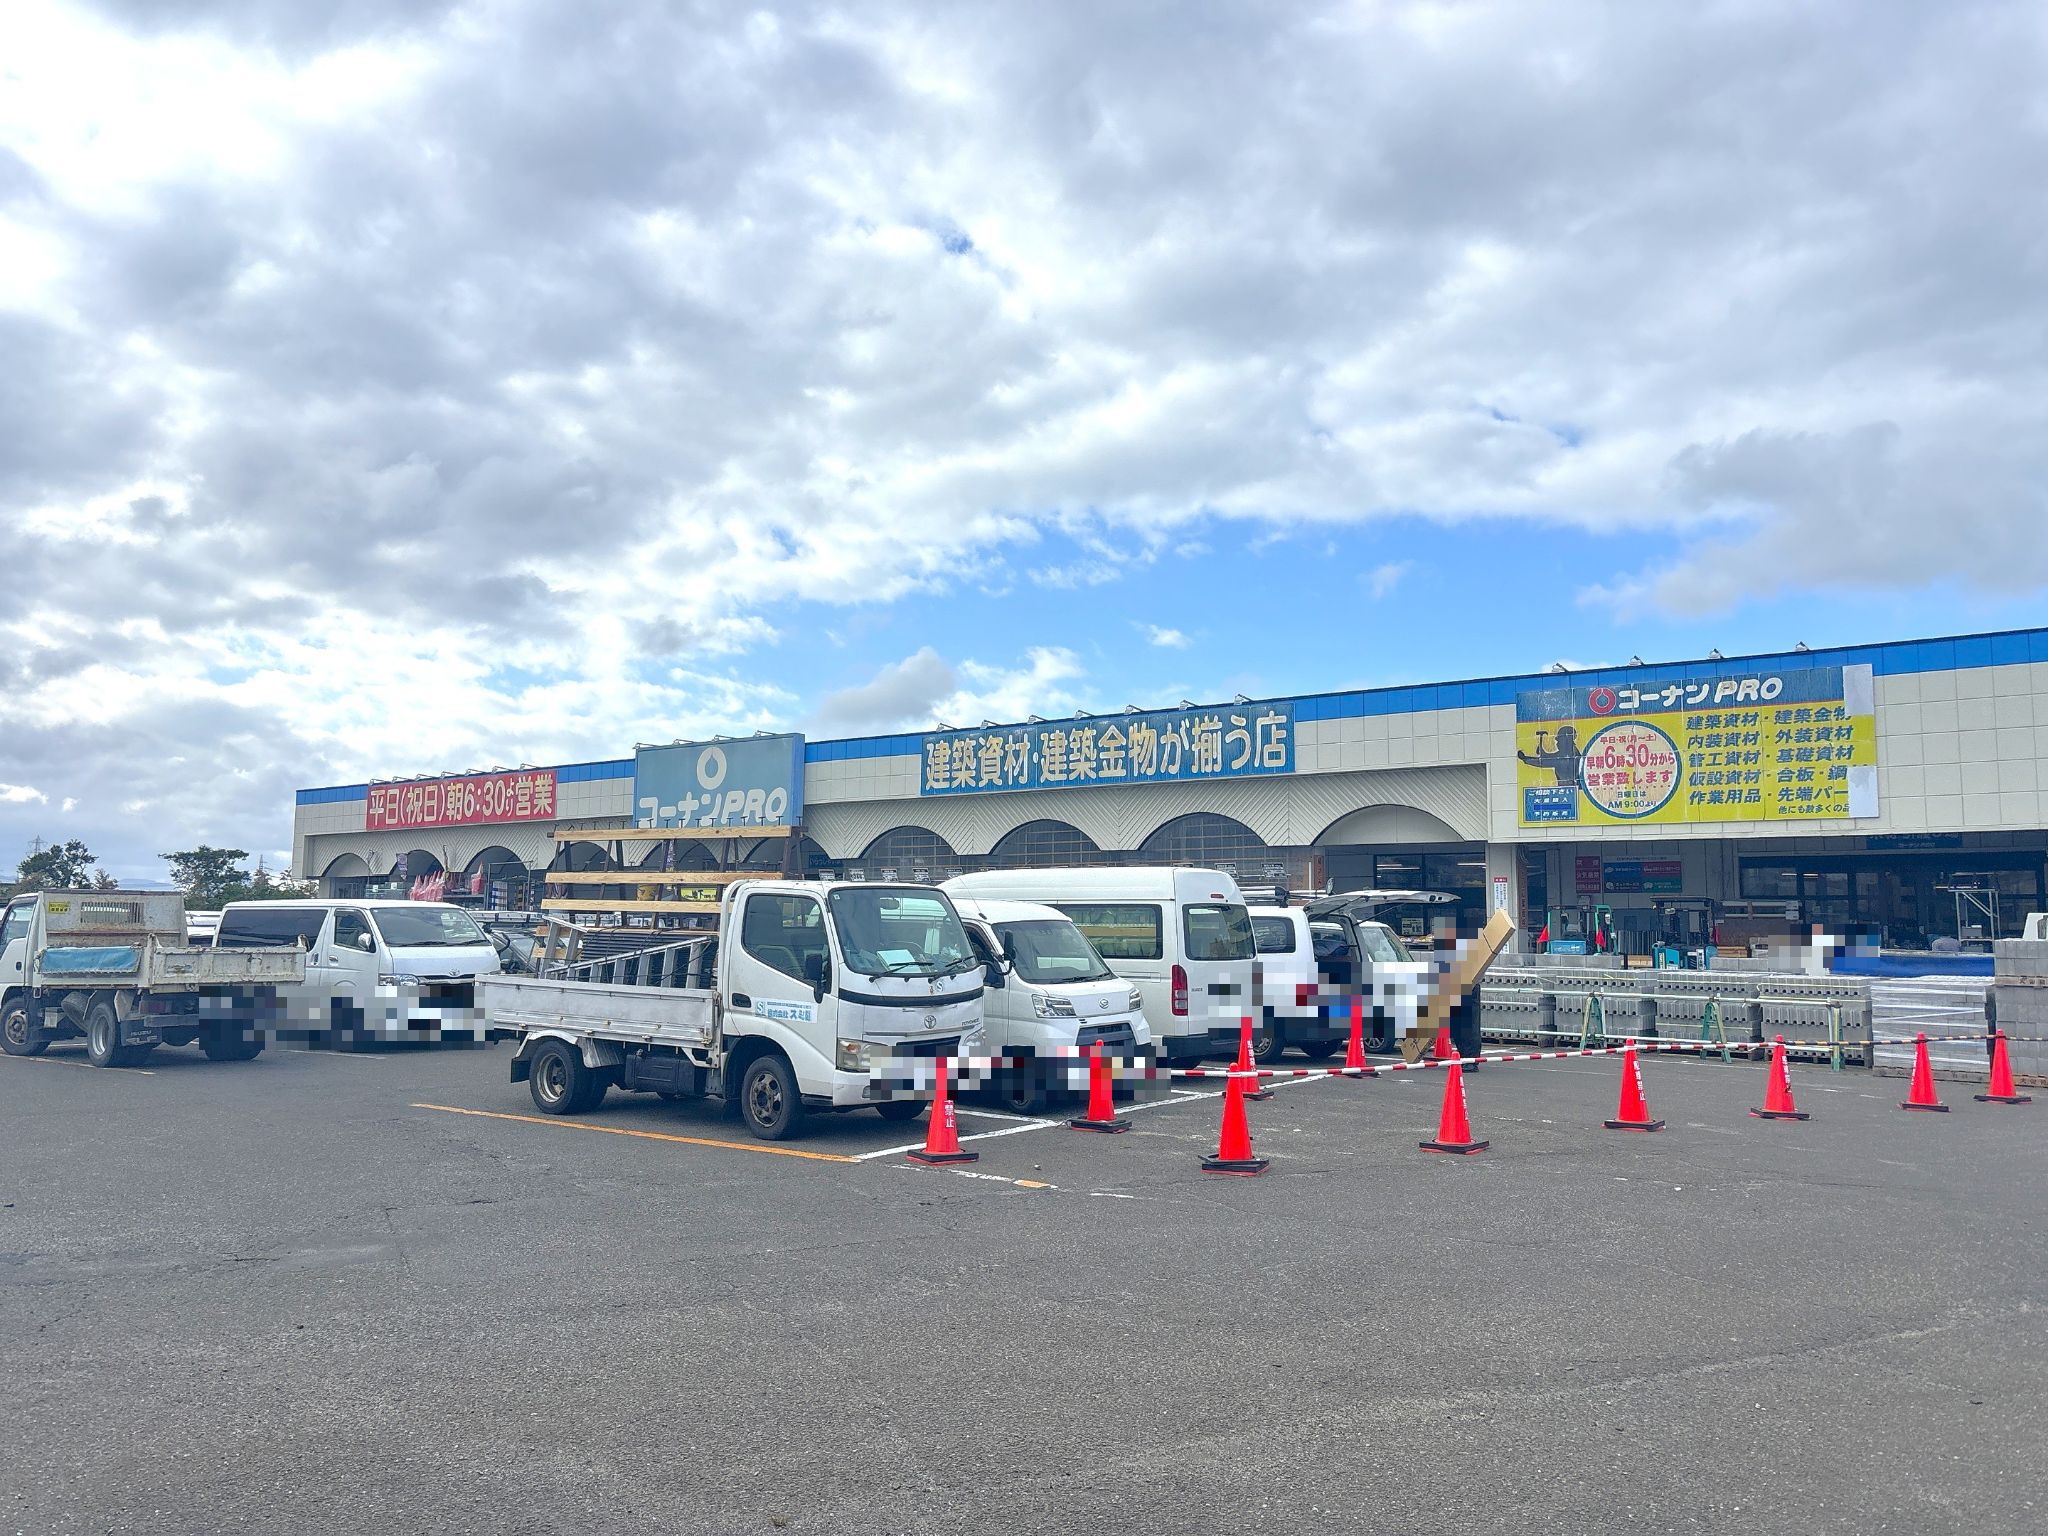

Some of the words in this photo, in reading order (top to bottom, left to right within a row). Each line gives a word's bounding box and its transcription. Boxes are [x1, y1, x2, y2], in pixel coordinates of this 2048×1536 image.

[926, 710, 1287, 790] 建築資材・建築金物が揃う店
[1587, 743, 1675, 769] 早朝6時30分から
[1587, 770, 1673, 786] 営業致します
[1617, 790, 1646, 798] 日曜日は
[369, 774, 553, 826] 平日(祝日)朝6:30より営業
[639, 787, 788, 828] コーナンPRO
